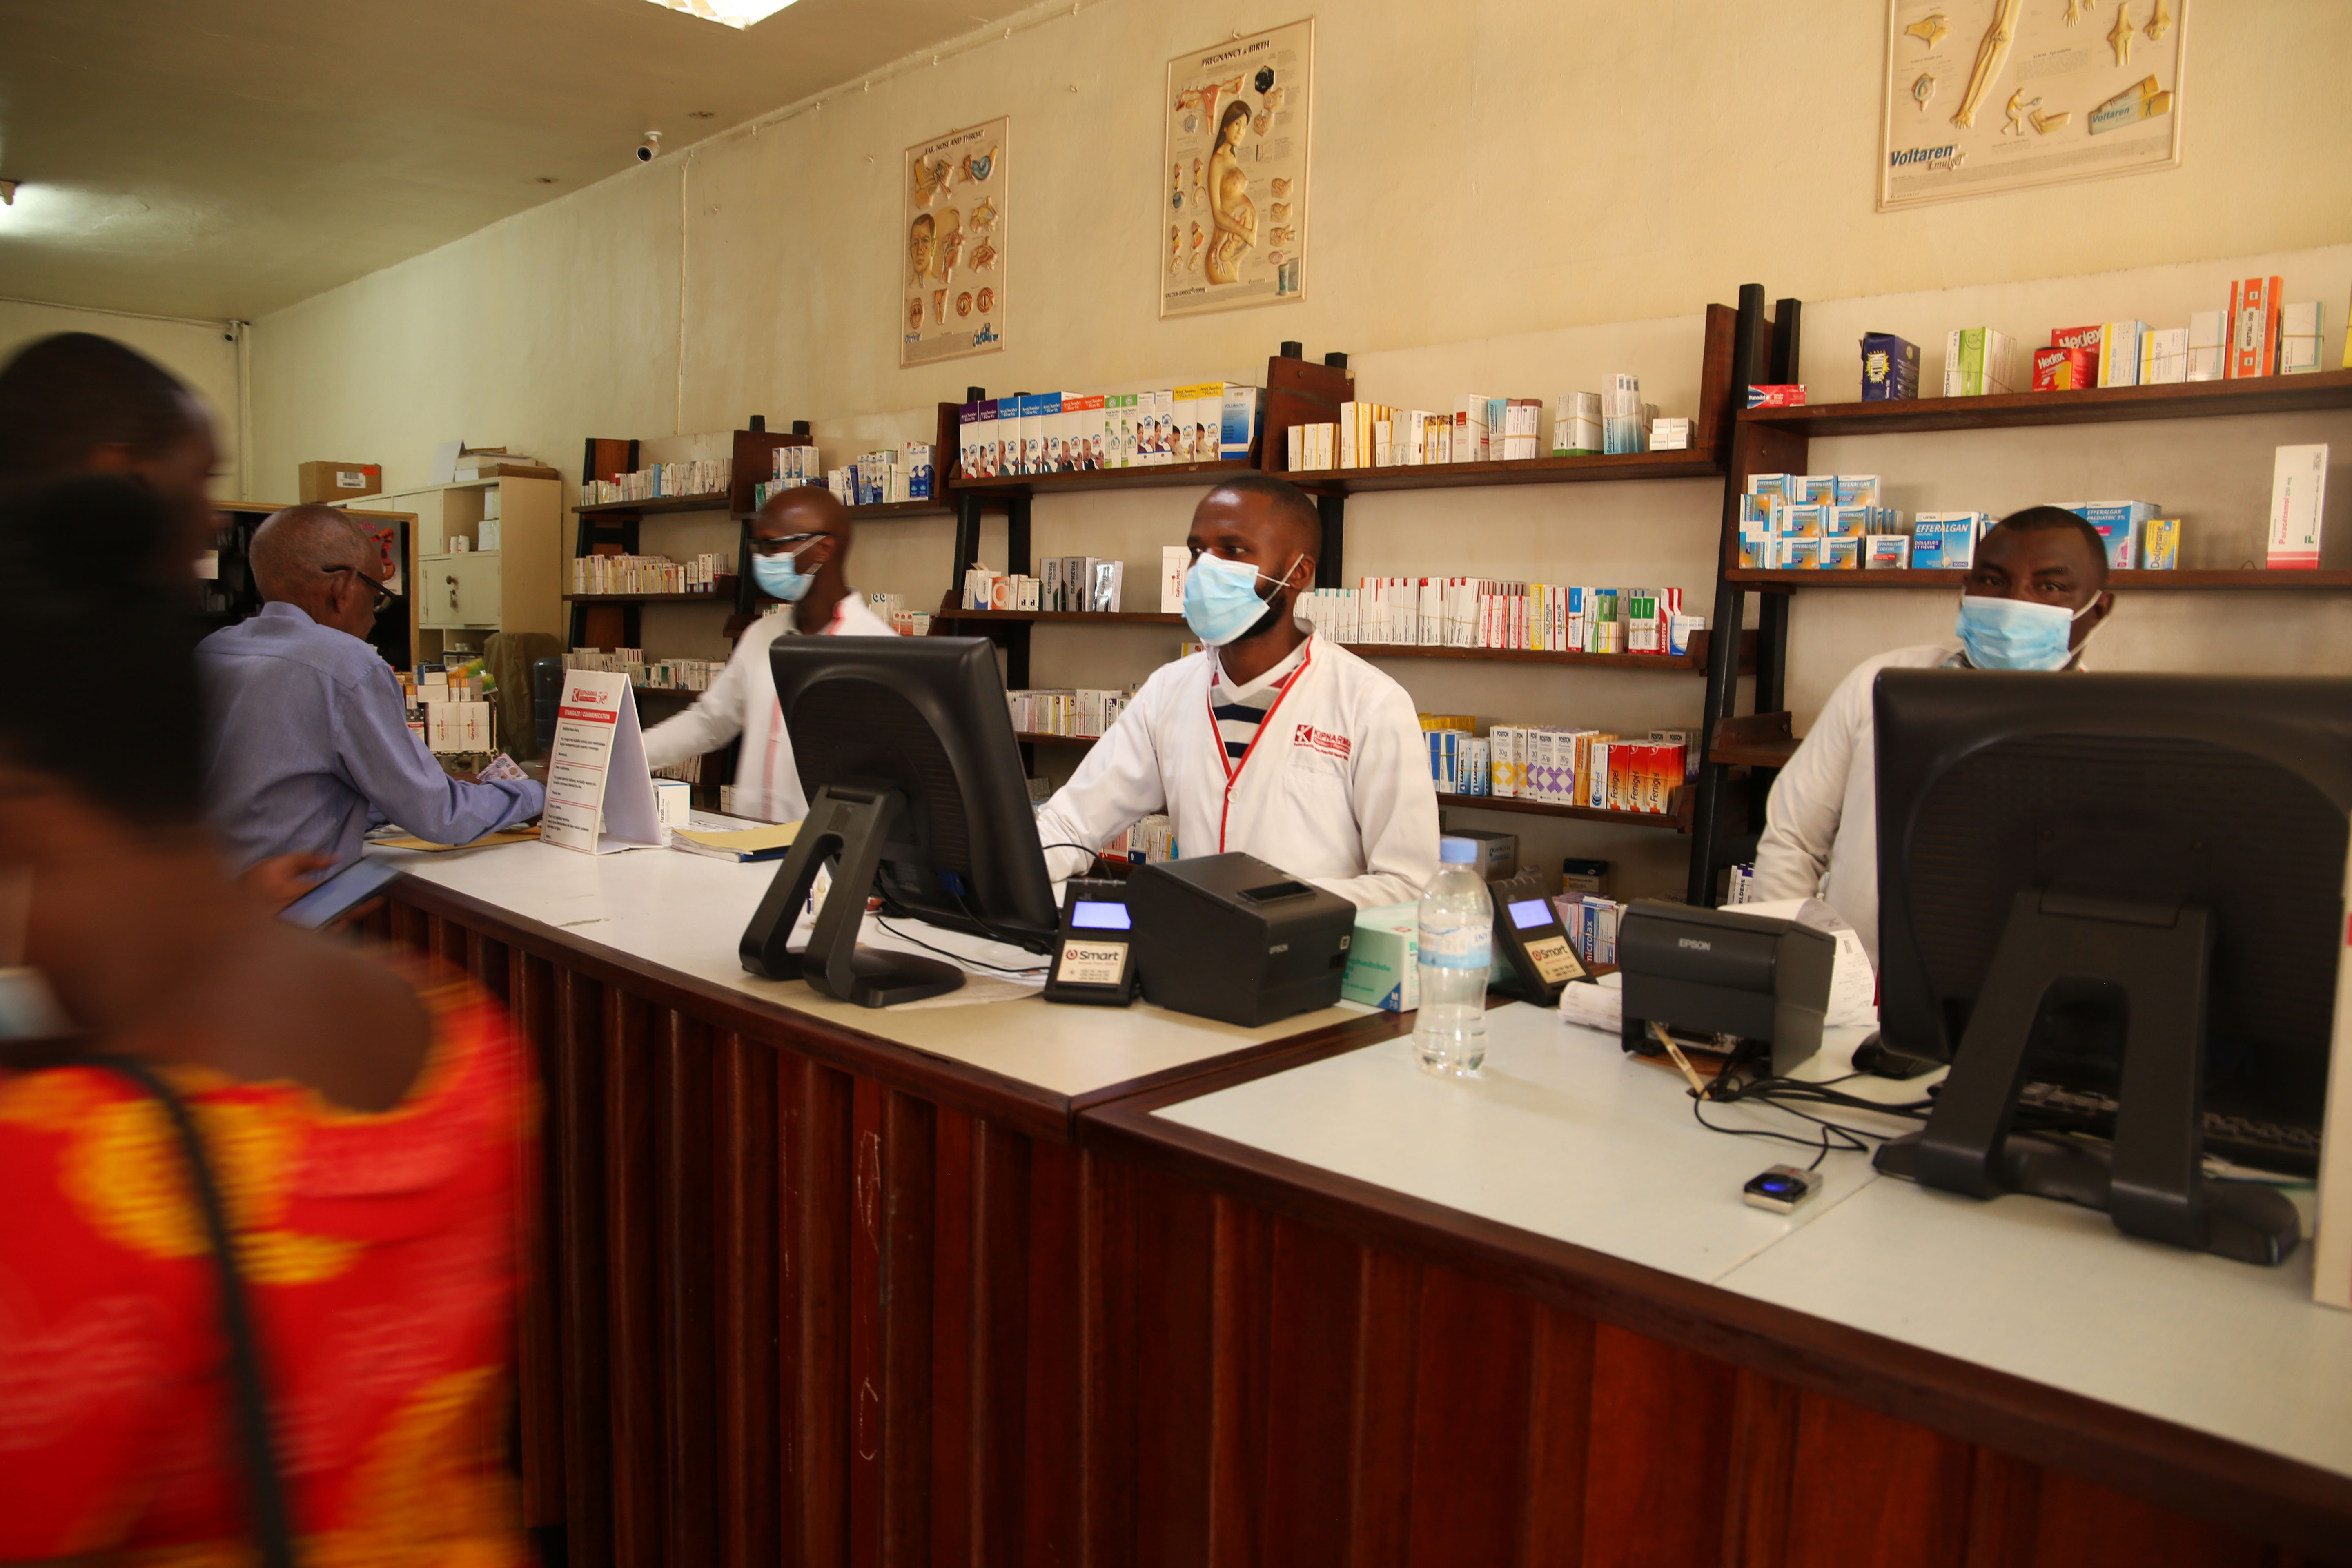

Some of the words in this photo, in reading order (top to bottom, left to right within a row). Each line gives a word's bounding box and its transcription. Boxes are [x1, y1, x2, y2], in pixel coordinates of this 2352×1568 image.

[1202, 48, 1243, 67] PREGNANCY
[1249, 40, 1270, 53] BIRTH
[2092, 107, 2130, 123] Voltaren
[951, 136, 962, 147] AND
[964, 129, 985, 143] THROAT
[1891, 146, 1954, 166] Voltaren
[2038, 351, 2065, 370] Hedex
[1916, 524, 1969, 533] EFFERALGAN
[2150, 526, 2163, 569] Doliprane
[582, 711, 611, 720] COMMUNICATION
[1611, 769, 1620, 799] Fenigel
[1631, 771, 1640, 800] Fenigel
[1650, 773, 1661, 802] Fenigel
[1541, 944, 1568, 959] Smart
[1679, 938, 1711, 951] EPSON
[1079, 951, 1119, 961] Smart
